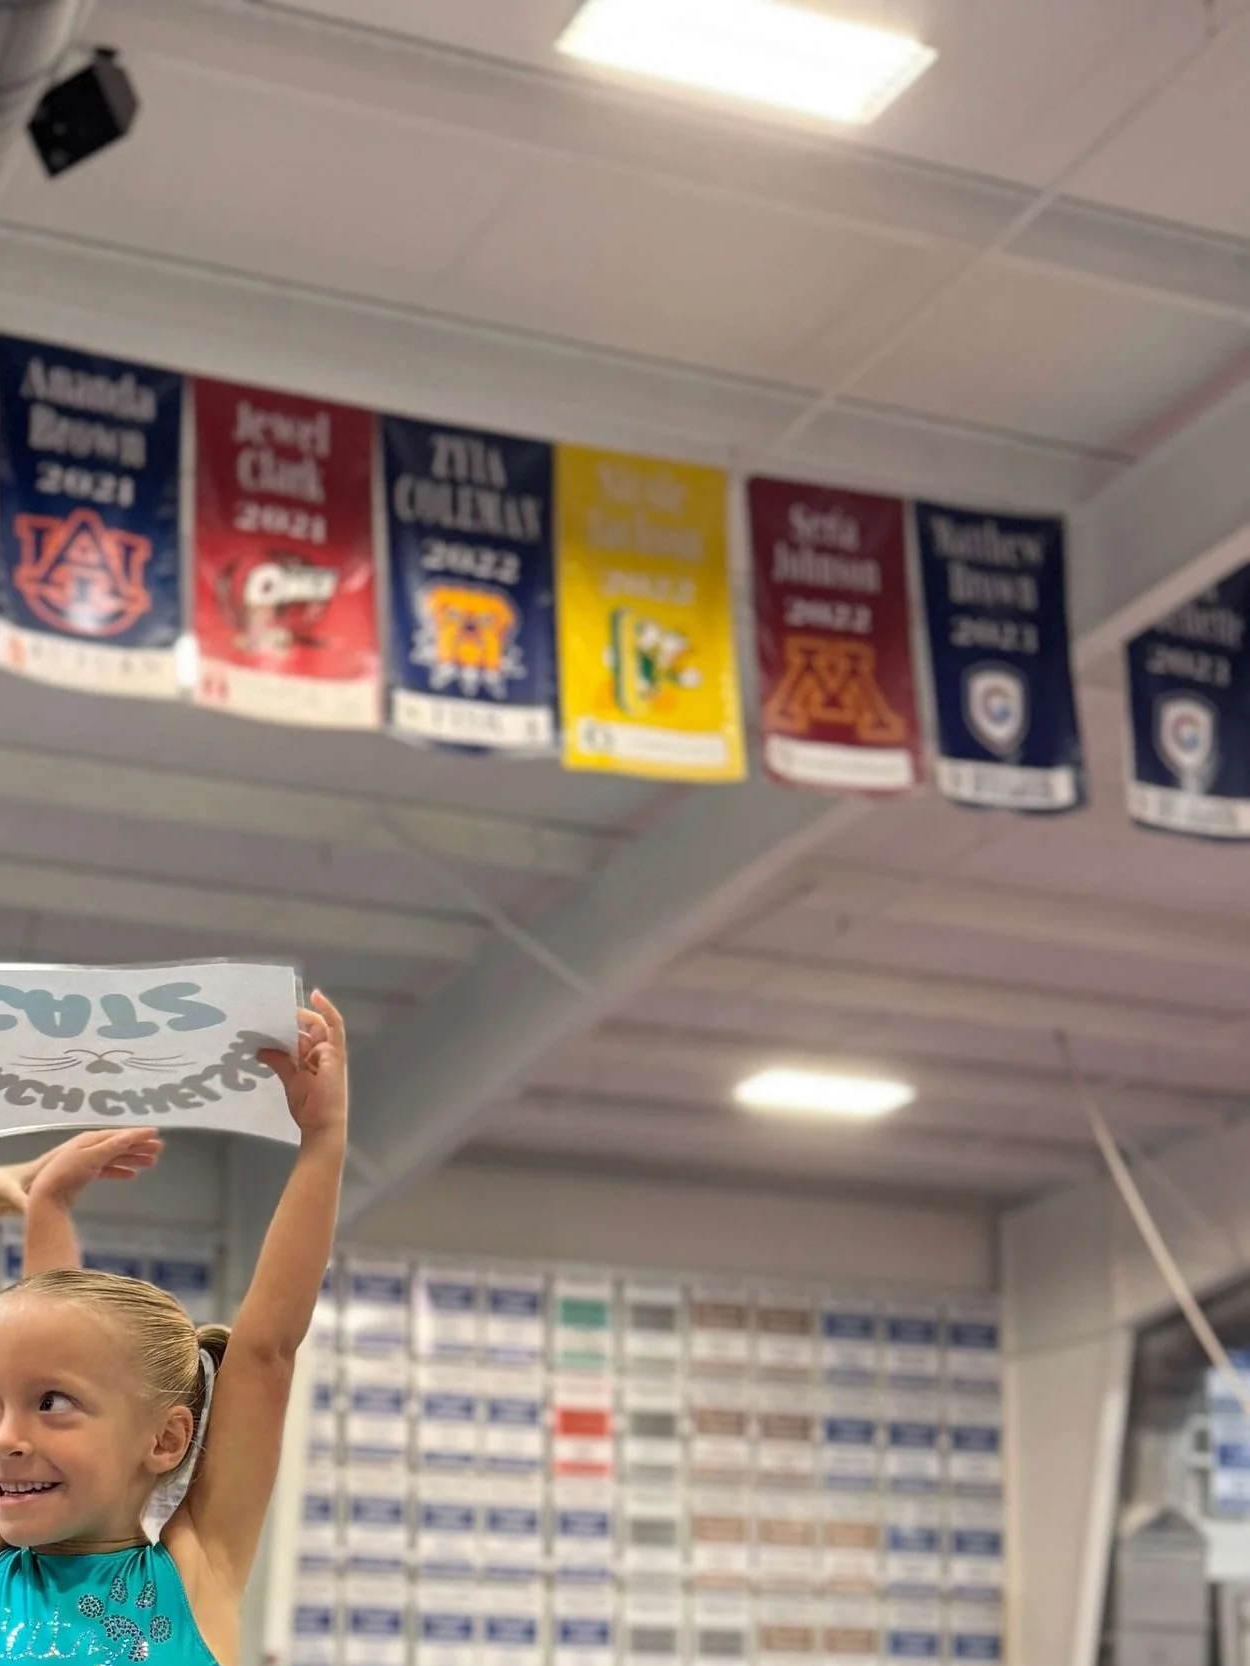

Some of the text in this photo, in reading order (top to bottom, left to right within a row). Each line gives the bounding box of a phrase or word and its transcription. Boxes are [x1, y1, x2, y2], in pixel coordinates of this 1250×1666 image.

[19, 355, 157, 424] Amanda
[27, 402, 147, 470] Brown
[35, 460, 136, 509] 2021
[394, 473, 543, 544] COLEMAN
[233, 499, 328, 546] 2021
[421, 538, 522, 585] 2022
[783, 596, 873, 635] 2022
